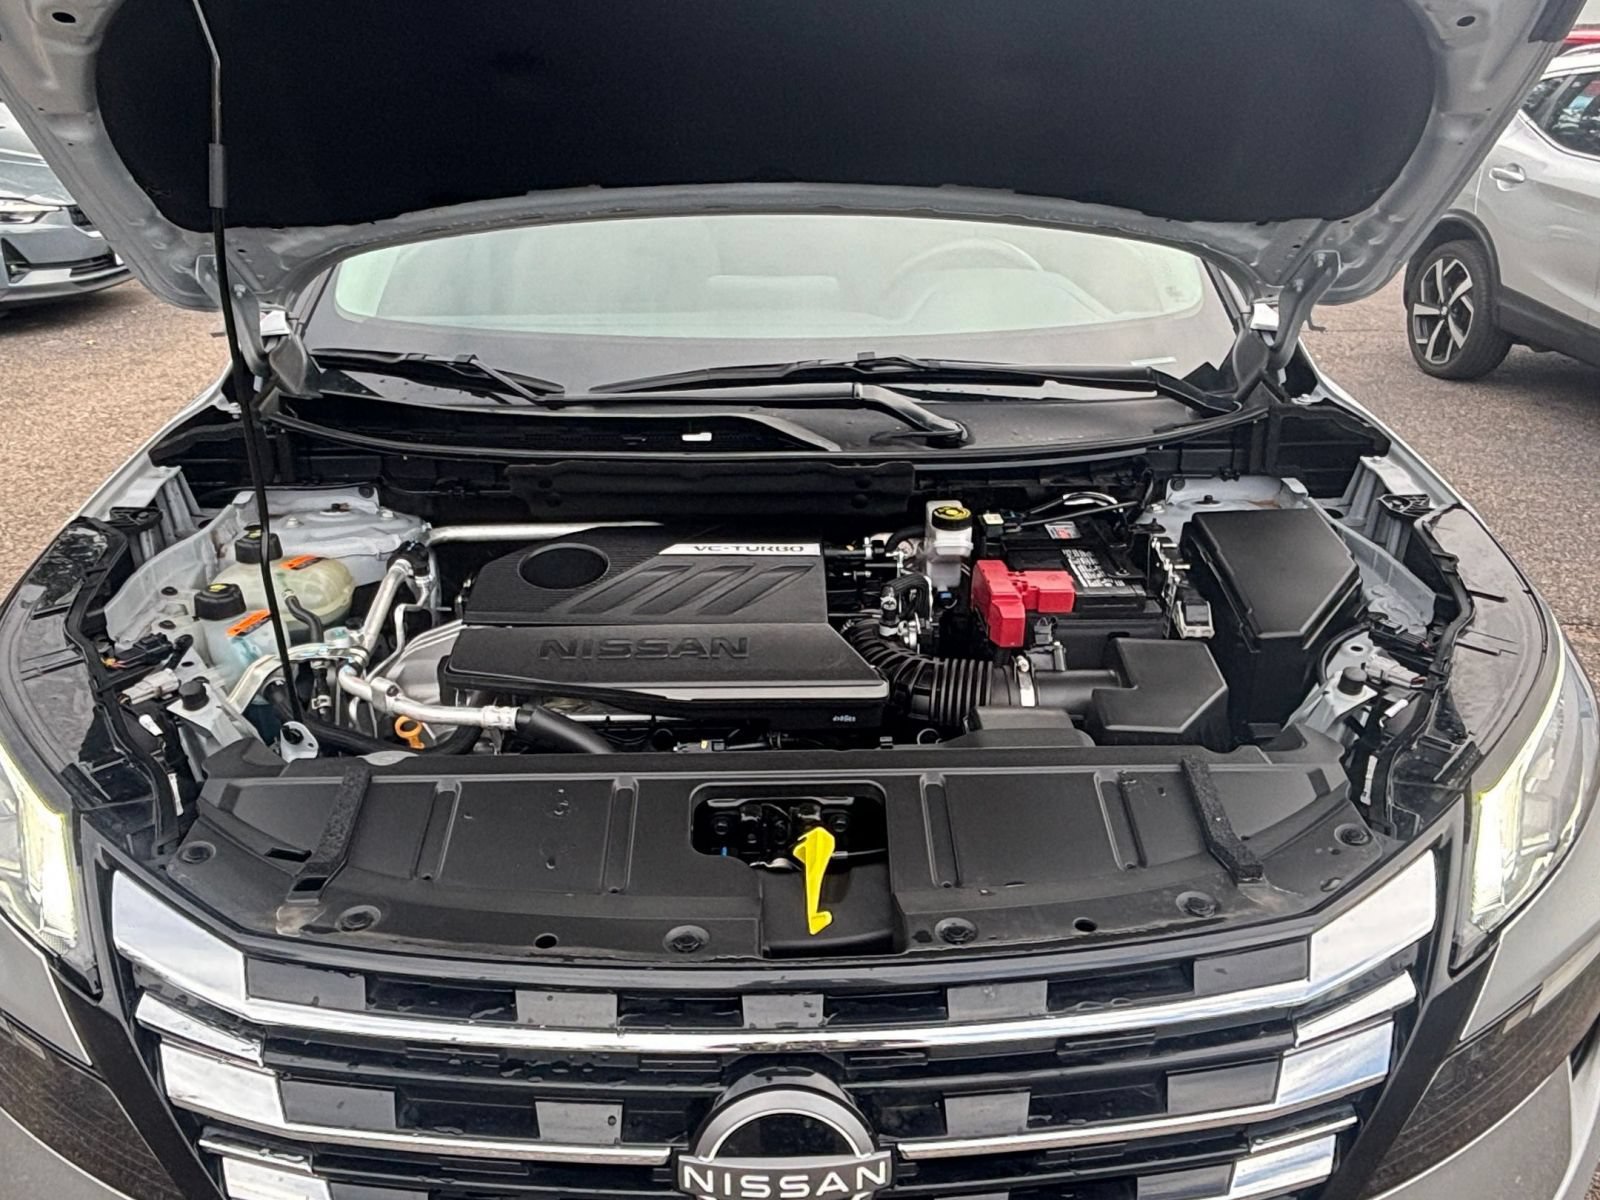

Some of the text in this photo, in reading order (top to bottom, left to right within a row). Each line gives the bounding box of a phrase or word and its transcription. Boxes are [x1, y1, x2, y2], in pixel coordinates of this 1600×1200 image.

[693, 545, 805, 553] VC-TURBO
[538, 637, 749, 660] NISSAN
[683, 1161, 886, 1199] NISSAN
